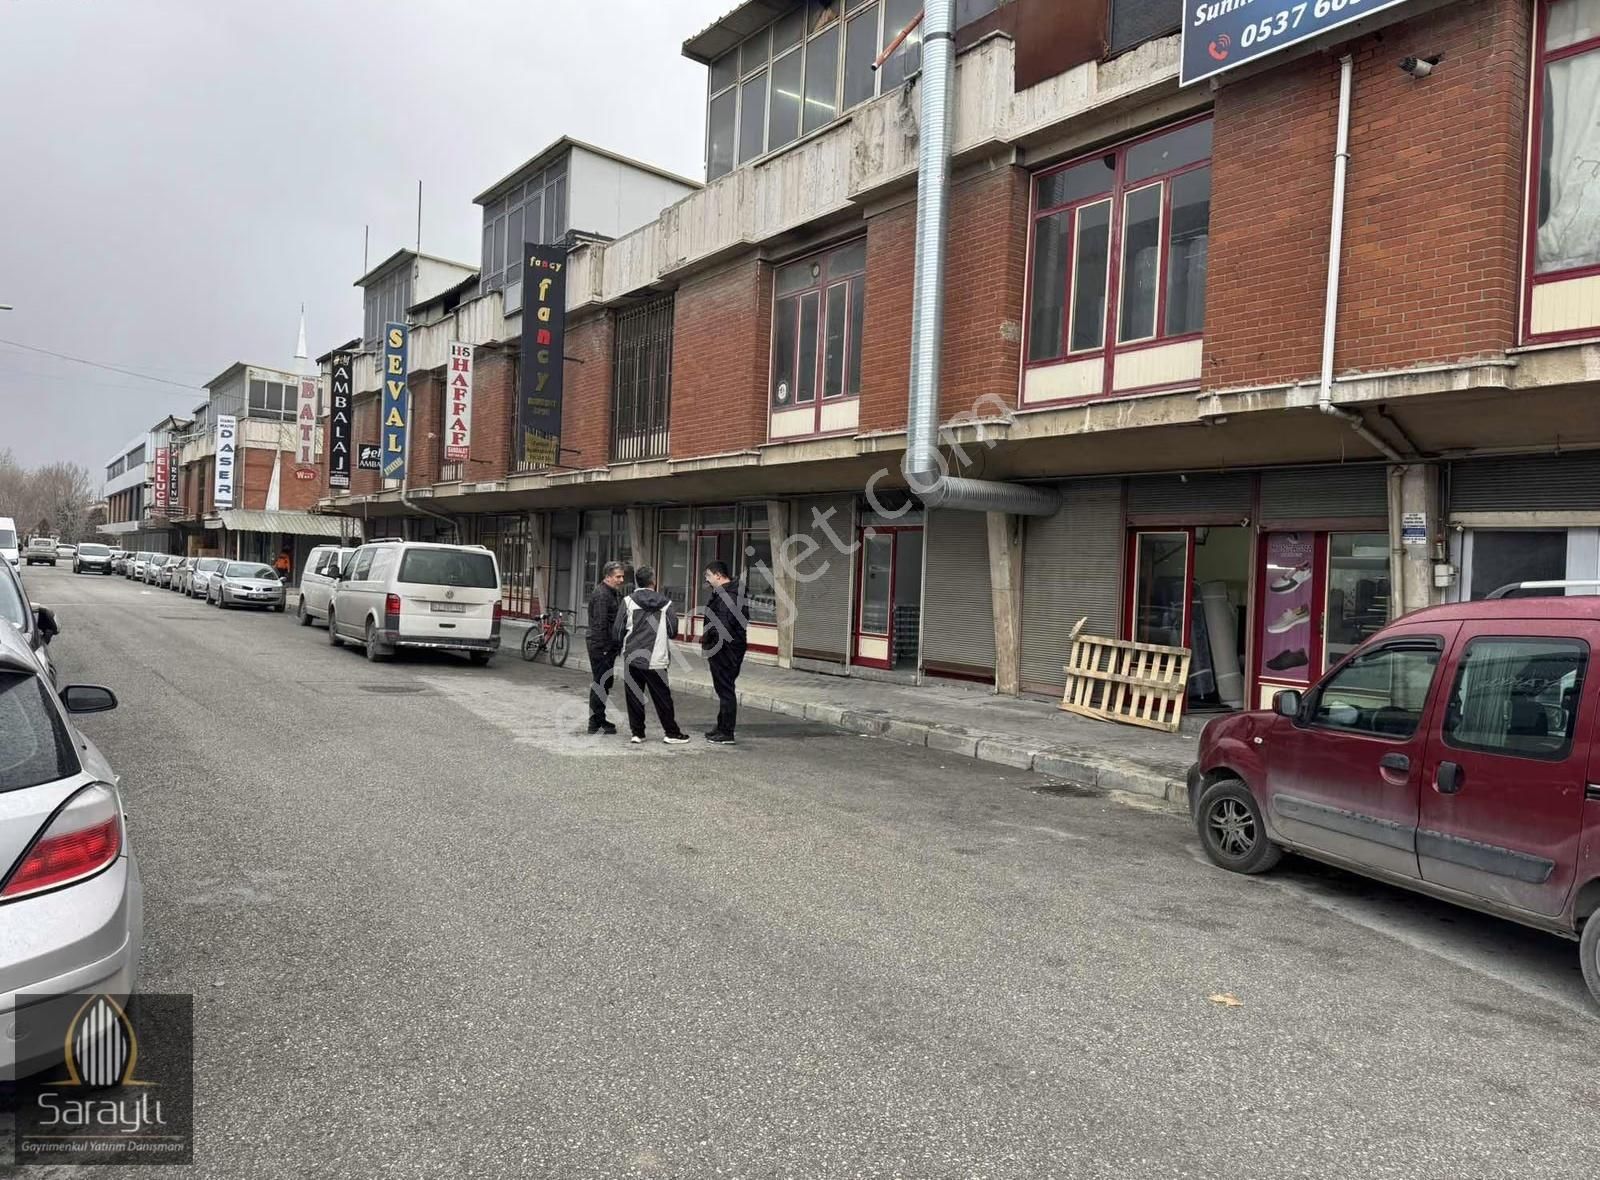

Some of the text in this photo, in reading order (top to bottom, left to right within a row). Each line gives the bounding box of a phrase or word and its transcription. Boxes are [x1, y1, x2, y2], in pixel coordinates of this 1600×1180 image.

[1194, 0, 1254, 26] Sunn
[1241, 0, 1360, 47] 0537 60
[530, 256, 562, 272] fancy
[537, 278, 552, 391] fancy
[300, 382, 315, 462] BATI
[333, 367, 349, 470] AMBALAJ
[385, 329, 404, 453] SEVAL
[449, 357, 469, 445] HAFFAF
[218, 430, 234, 494] DASER
[360, 460, 382, 468] AMBA
